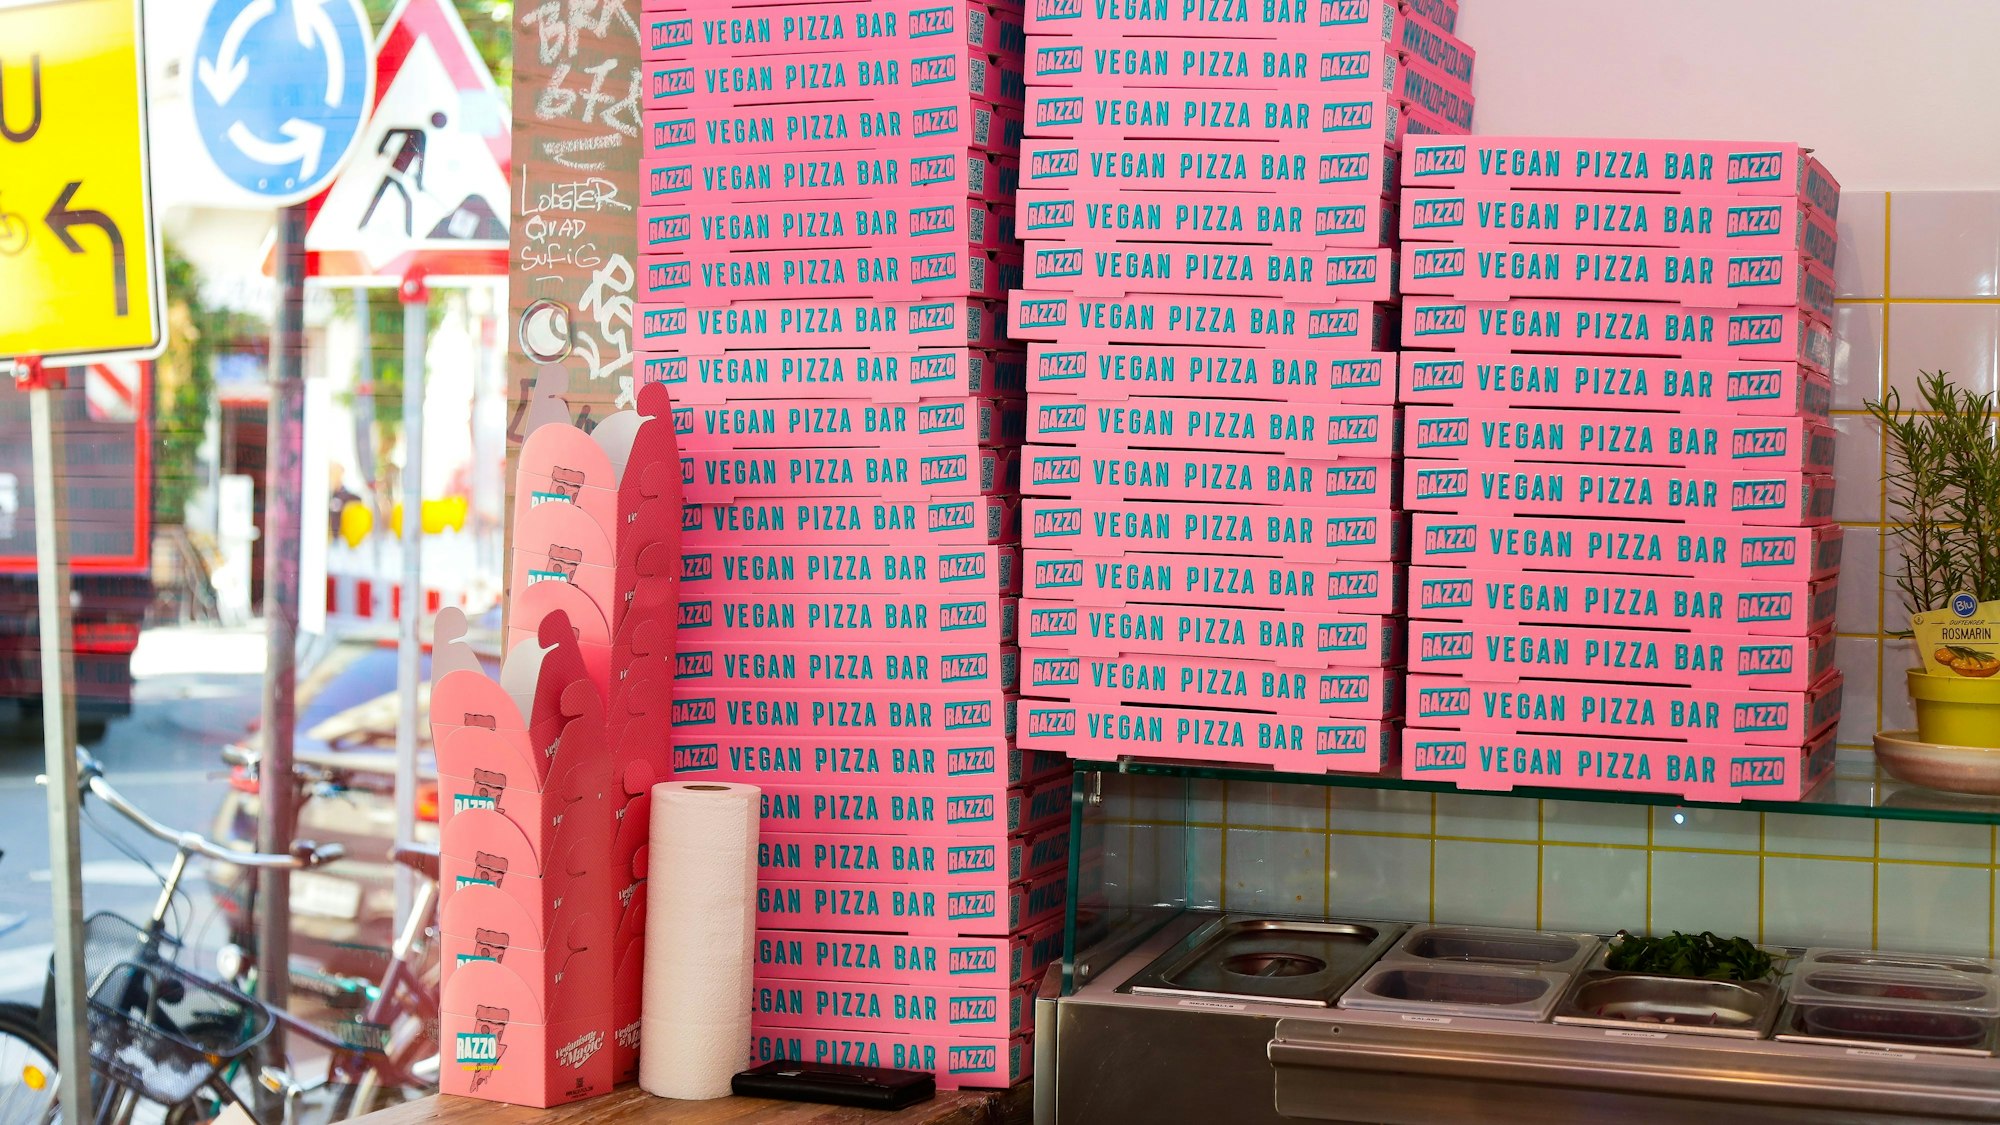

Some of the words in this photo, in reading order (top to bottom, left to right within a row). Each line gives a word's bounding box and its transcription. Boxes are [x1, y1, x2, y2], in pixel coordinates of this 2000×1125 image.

[652, 21, 692, 48] RAZZO
[703, 18, 771, 45] VEGAN
[783, 15, 844, 41] PIZZA
[856, 11, 897, 38] BAR
[909, 8, 953, 36] RAZZO
[1037, 48, 1082, 73] RAZZO
[1094, 49, 1168, 75] VEGAN
[1183, 50, 1249, 77] PIZZA
[1263, 51, 1307, 78] BAR
[1321, 53, 1370, 79] RAZZO
[655, 121, 695, 147] RAZZO
[706, 118, 774, 145] VEGAN
[787, 114, 848, 140] PIZZA
[860, 111, 901, 138] BAR
[913, 108, 957, 136] RAZZO
[1032, 151, 1078, 177] RAZZO
[1091, 151, 1165, 178] VEGAN
[1180, 152, 1247, 179] PIZZA
[1261, 154, 1306, 180] BAR
[1320, 155, 1369, 181] RAZZO
[1415, 148, 1466, 174] RAZZO
[1479, 149, 1560, 177] VEGAN
[1576, 150, 1649, 179] PIZZA
[1664, 152, 1713, 180] BAR
[1728, 154, 1782, 181] RAZZO
[649, 216, 690, 242] RAZZO
[701, 214, 769, 241] VEGAN
[783, 211, 844, 237] PIZZA
[856, 209, 897, 236] BAR
[910, 208, 954, 234] RAZZO
[1036, 251, 1083, 276] RAZZO
[1095, 252, 1171, 279] VEGAN
[1185, 253, 1253, 281] PIZZA
[1267, 255, 1313, 282] BAR
[1327, 258, 1376, 283] RAZZO
[1414, 251, 1464, 277] RAZZO
[1478, 252, 1559, 280] VEGAN
[1576, 253, 1649, 282] PIZZA
[1664, 256, 1713, 284] BAR
[1728, 258, 1782, 285] RAZZO
[644, 310, 686, 336] RAZZO
[697, 309, 767, 335] VEGAN
[780, 308, 843, 333] PIZZA
[855, 306, 897, 332] BAR
[910, 305, 954, 332] RAZZO
[645, 359, 687, 383] RAZZO
[698, 358, 768, 384] VEGAN
[781, 357, 844, 383] PIZZA
[856, 357, 898, 382] BAR
[911, 356, 955, 382] RAZZO
[1039, 354, 1086, 379] RAZZO
[1099, 355, 1175, 382] VEGAN
[1189, 356, 1257, 384] PIZZA
[1272, 359, 1317, 385] BAR
[1331, 361, 1381, 386] RAZZO
[1413, 363, 1464, 389] RAZZO
[1477, 365, 1559, 393] VEGAN
[1575, 367, 1648, 395] PIZZA
[1663, 369, 1713, 397] BAR
[1728, 372, 1781, 399] RAZZO
[705, 460, 776, 485] VEGAN
[789, 459, 853, 484] PIZZA
[865, 458, 908, 483] BAR
[921, 457, 966, 483] RAZZO
[1033, 458, 1080, 483] RAZZO
[1093, 459, 1169, 487] VEGAN
[1184, 462, 1252, 490] PIZZA
[1267, 465, 1313, 493] BAR
[1327, 469, 1376, 494] RAZZO
[1418, 471, 1467, 497] RAZZO
[1481, 473, 1563, 502] VEGAN
[1579, 476, 1652, 505] PIZZA
[1668, 479, 1717, 507] BAR
[1732, 483, 1786, 508] RAZZO
[1036, 562, 1083, 586] RAZZO
[1095, 563, 1171, 591] VEGAN
[1186, 566, 1254, 594] PIZZA
[1269, 569, 1314, 596] BAR
[1328, 573, 1378, 598] RAZZO
[677, 603, 712, 627] AZZO
[723, 603, 795, 628] VEGAN
[808, 603, 872, 629] PIZZA
[885, 603, 927, 629] BAR
[940, 604, 986, 629] RAZZO
[1422, 582, 1472, 606] RAZZO
[1486, 583, 1568, 612] VEGAN
[1585, 587, 1658, 615] PIZZA
[1674, 590, 1723, 618] BAR
[1738, 594, 1791, 620] RAZZO
[1957, 600, 1973, 612] Blu
[1942, 627, 1992, 640] ROSMARIN
[1033, 660, 1079, 684] RAZZO
[1091, 662, 1166, 691] VEGAN
[1181, 667, 1247, 696] PIZZA
[1261, 672, 1306, 699] BAR
[1320, 678, 1368, 701] RAZZO
[672, 700, 715, 725] RAZZO
[727, 701, 798, 725] VEGAN
[812, 701, 876, 727] PIZZA
[889, 702, 931, 727] BAR
[945, 703, 991, 728] RAZZO
[1420, 690, 1470, 715] RAZZO
[1483, 692, 1565, 721] VEGAN
[1582, 696, 1655, 725] PIZZA
[1671, 700, 1719, 728] BAR
[1735, 704, 1788, 730] RAZZO
[1030, 712, 1075, 735] RAZZO
[1087, 713, 1162, 742] VEGAN
[1177, 718, 1244, 747] PIZZA
[1258, 723, 1303, 750] BAR
[1317, 728, 1365, 752] RAZZO
[674, 746, 718, 771] RAZZO
[729, 747, 801, 772] VEGAN
[815, 748, 879, 773] PIZZA
[892, 748, 935, 773] BAR
[948, 749, 994, 774] RAZZO
[1416, 744, 1466, 768] RAZZO
[1479, 746, 1561, 775] VEGAN
[1578, 750, 1651, 779] PIZZA
[1667, 755, 1715, 783] BAR
[1731, 760, 1784, 784] RAZZO
[758, 844, 800, 868] GAN
[815, 845, 879, 870] PIZZA
[892, 846, 935, 871] BAR
[948, 848, 994, 872] RAZZO
[757, 940, 802, 965] GAN
[816, 942, 881, 968] PIZZA
[893, 945, 936, 971] BAR
[950, 949, 995, 972] RAZZO
[456, 1037, 497, 1059] RAZZO
